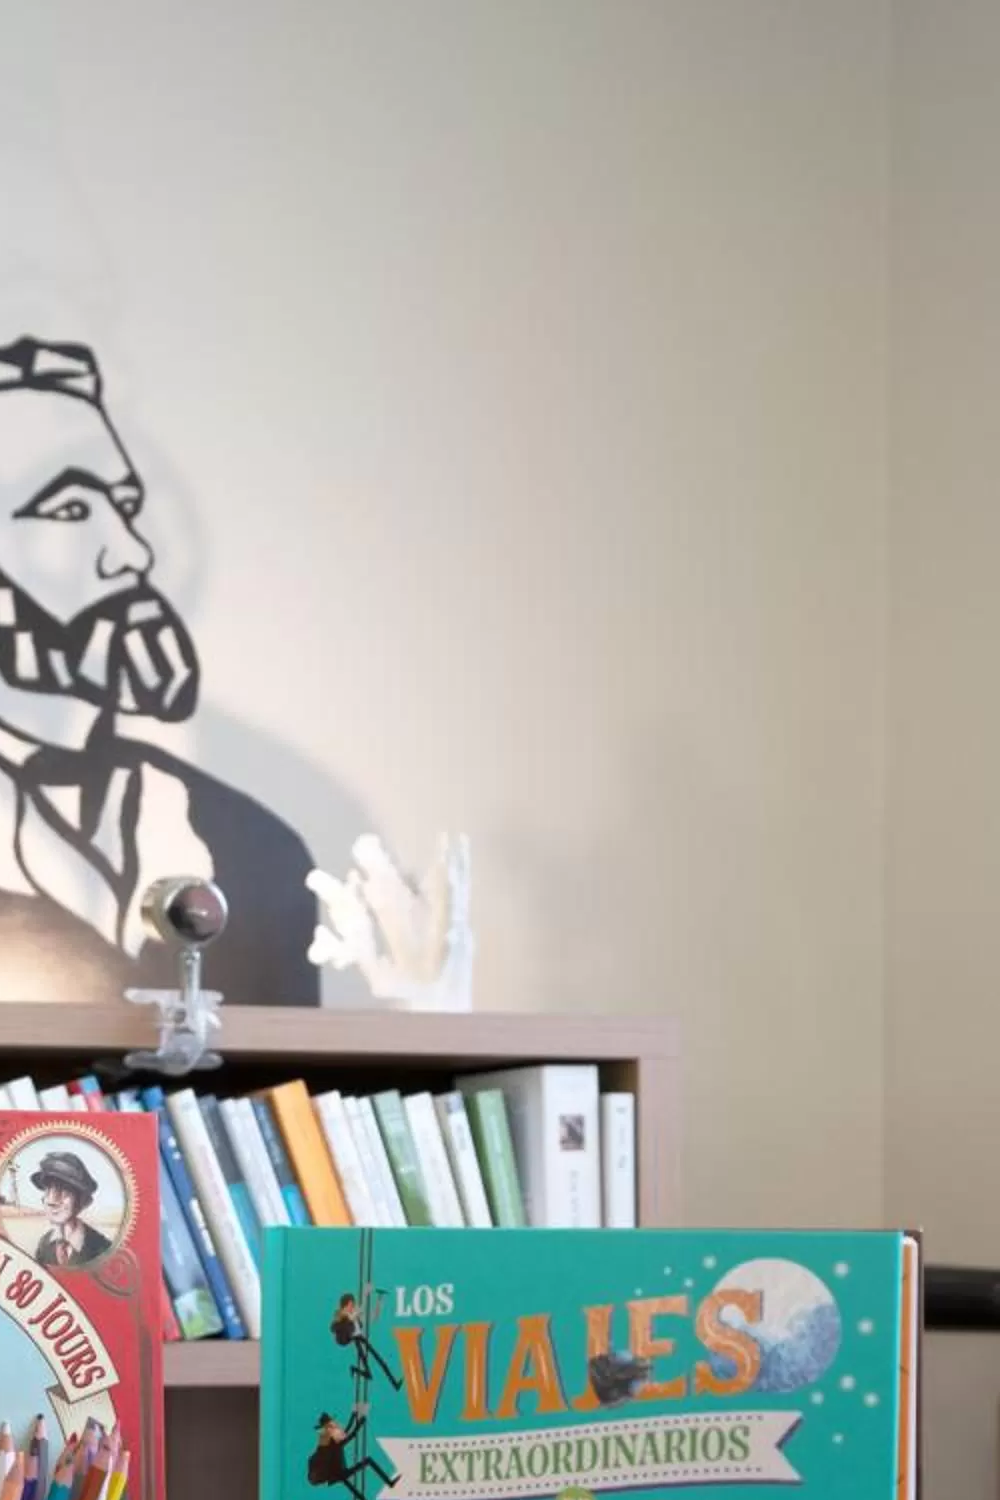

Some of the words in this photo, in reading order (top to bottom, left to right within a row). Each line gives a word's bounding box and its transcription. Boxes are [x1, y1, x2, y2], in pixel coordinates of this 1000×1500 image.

[4, 1269, 44, 1310] 80
[28, 1294, 106, 1391] JOURS
[395, 1283, 454, 1318] LOS
[392, 1287, 764, 1425] VIAJES
[418, 1425, 751, 1485] EXTRAORDINARIOS
